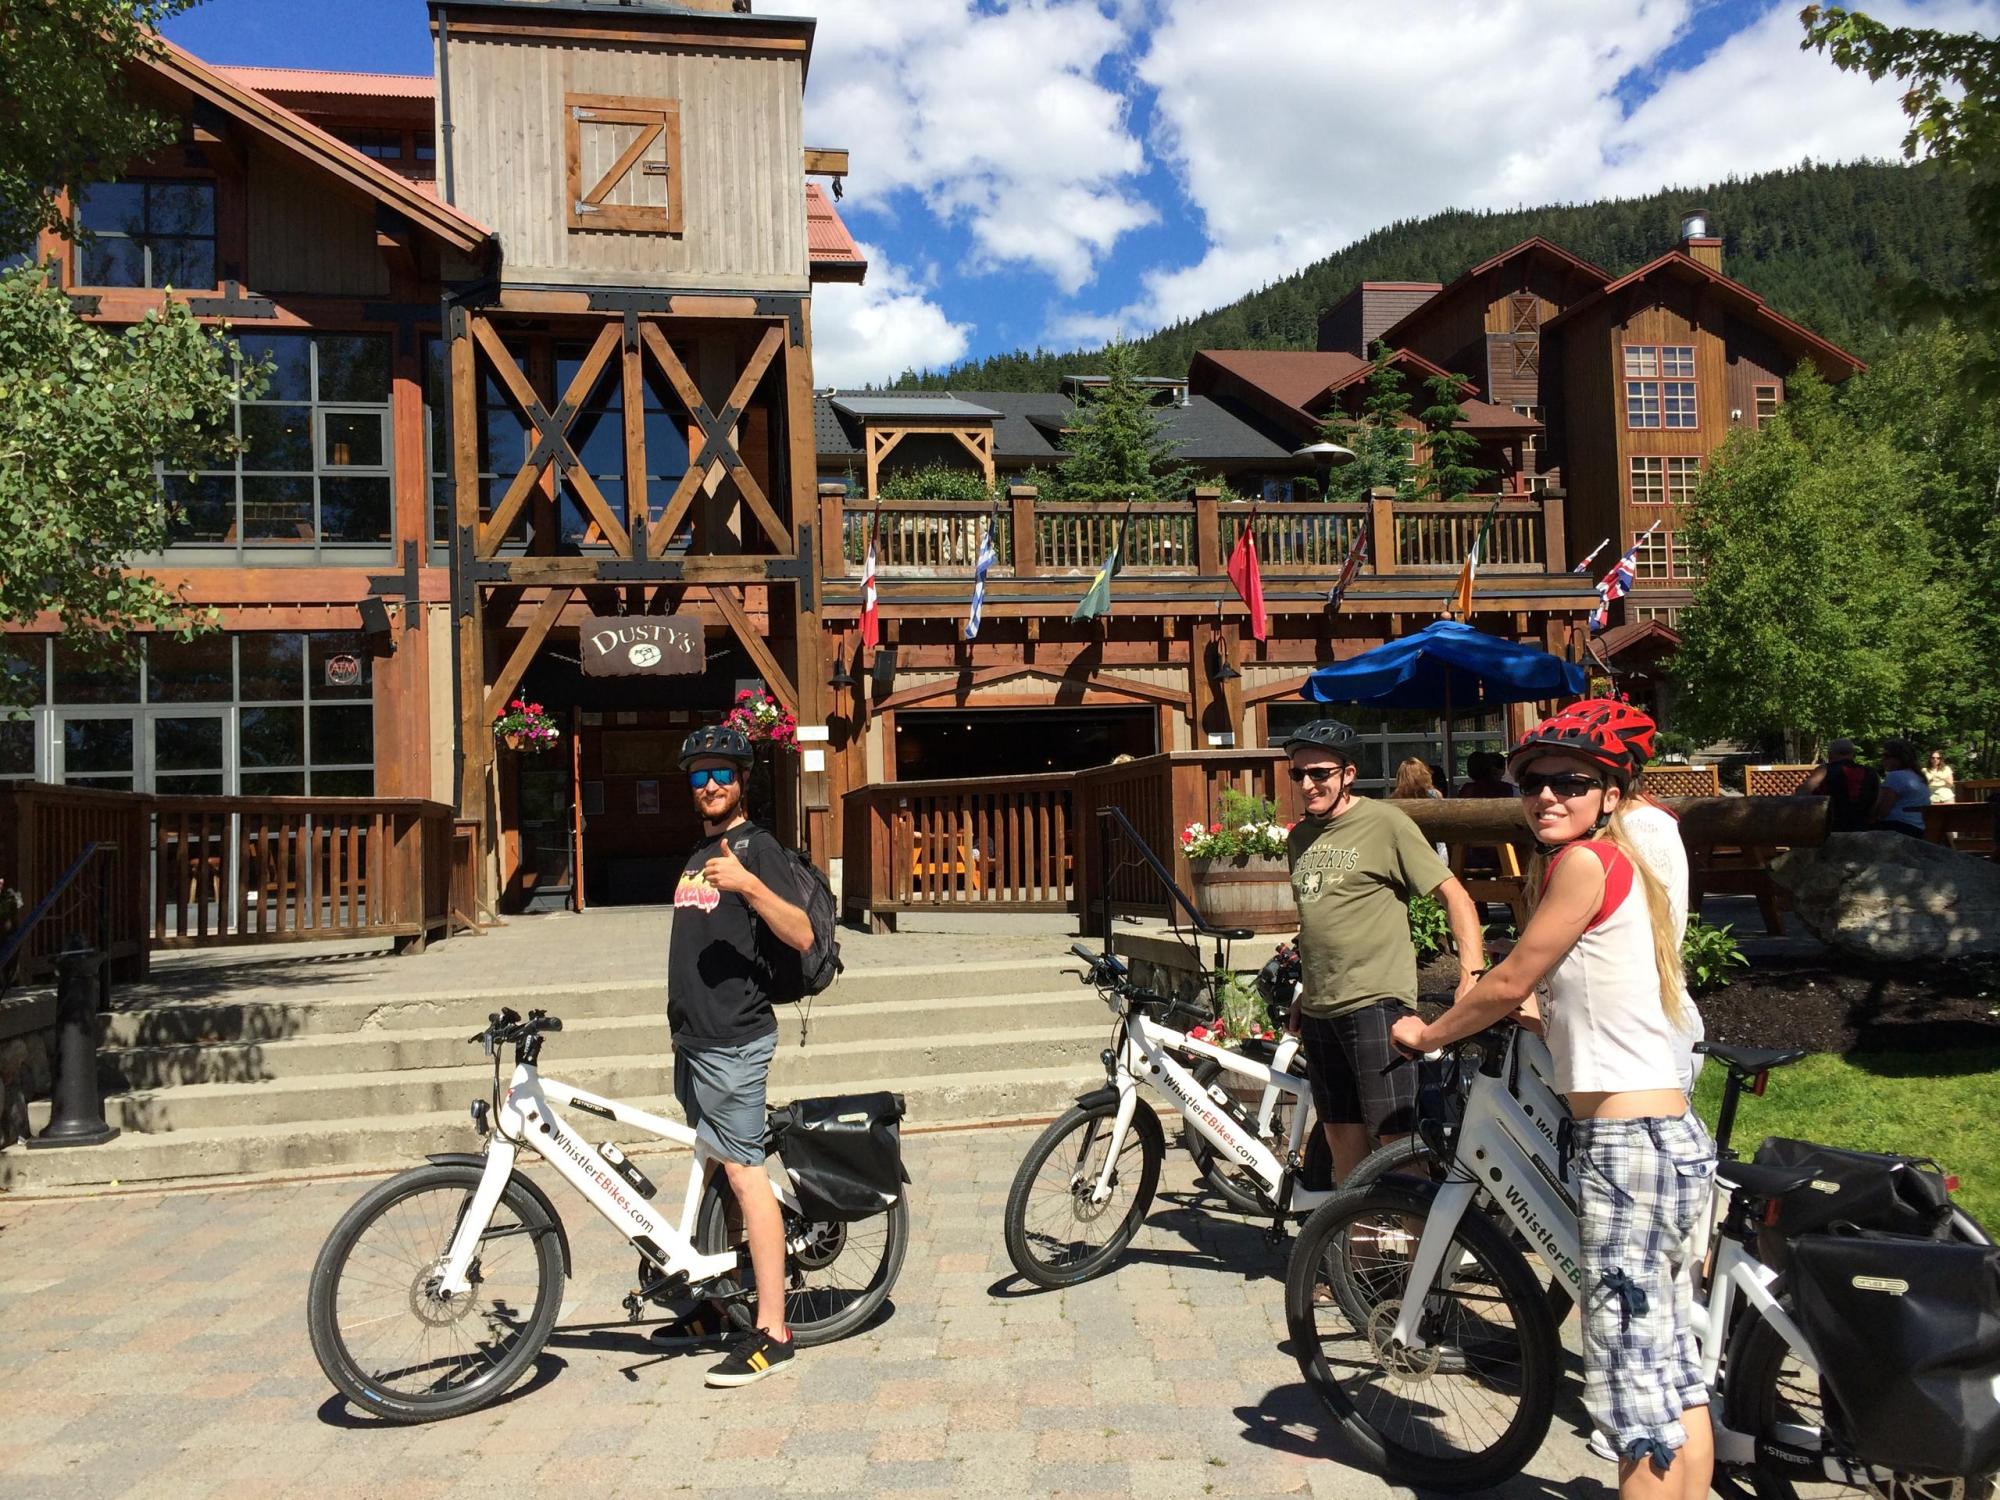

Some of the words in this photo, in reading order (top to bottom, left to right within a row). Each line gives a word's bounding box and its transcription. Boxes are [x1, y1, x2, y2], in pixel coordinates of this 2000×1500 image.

[331, 661, 356, 674] ATM
[591, 625, 696, 656] DUSTY'S
[1163, 1074, 1259, 1167] WhistlerEBikes.com
[553, 1129, 655, 1233] WhistlerEBikes.com
[1505, 1184, 1582, 1290] WhistlerEB
